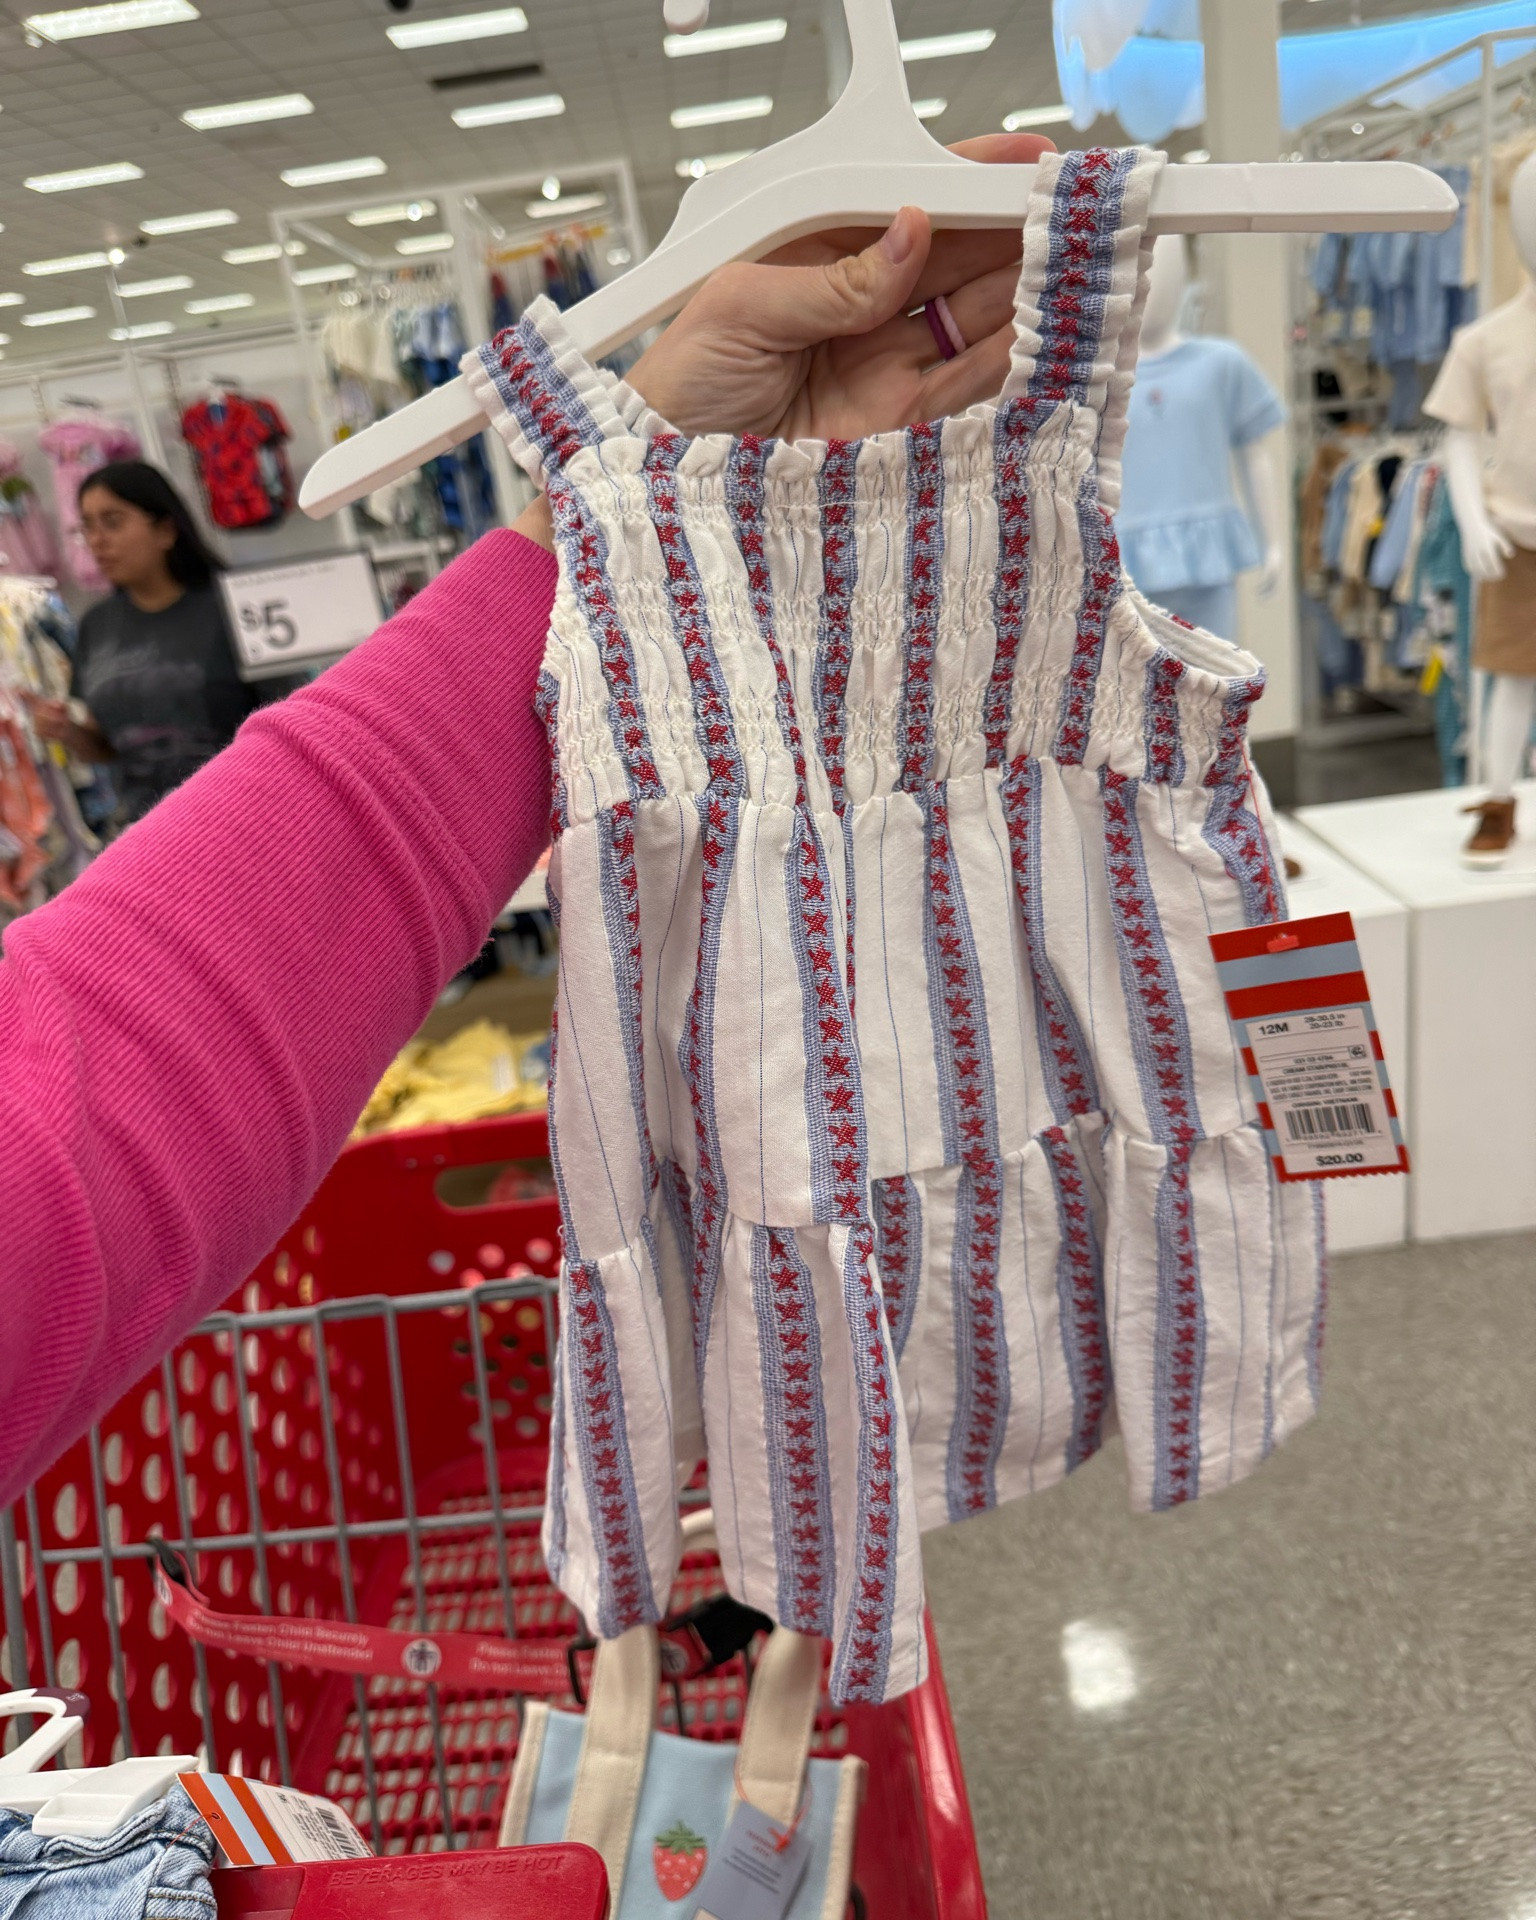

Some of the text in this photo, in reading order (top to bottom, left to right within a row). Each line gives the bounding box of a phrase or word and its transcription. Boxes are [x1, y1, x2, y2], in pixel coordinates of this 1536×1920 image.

[240, 599, 298, 649] $5
[1259, 1022, 1289, 1035] 12M
[1316, 1153, 1364, 1166] $20.00
[329, 1856, 565, 1886] BEVERAGES MAY BE HOT
